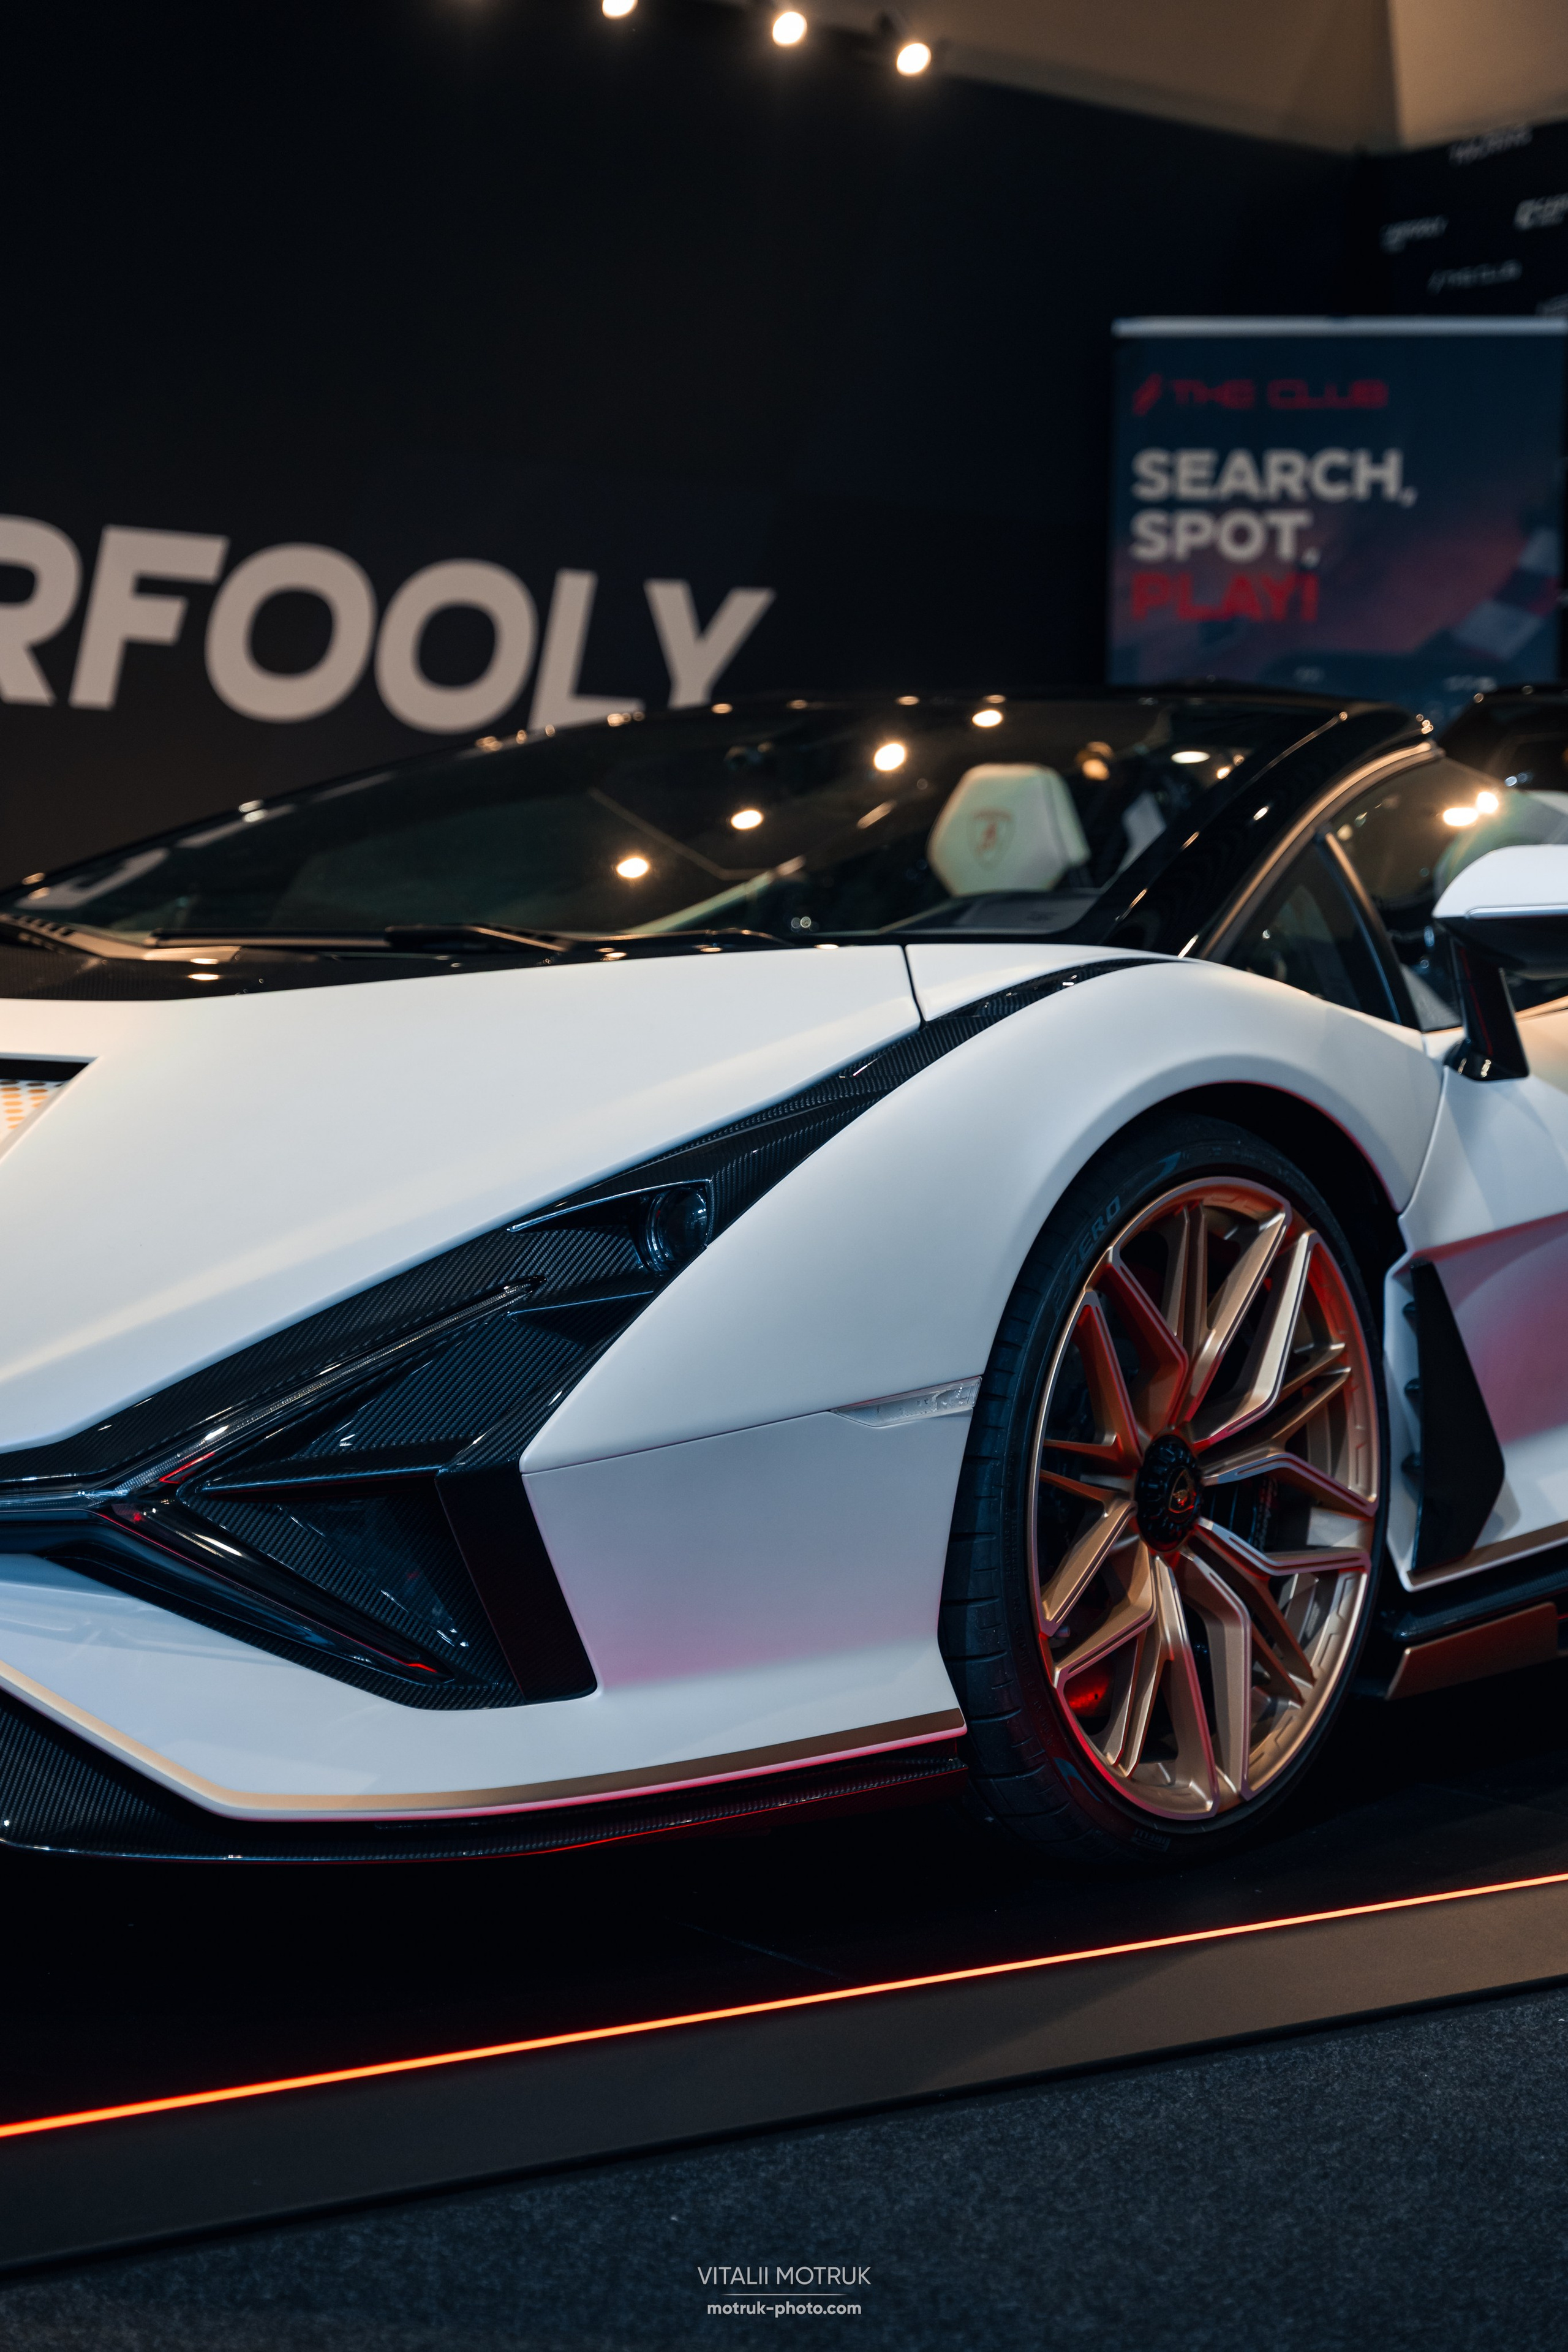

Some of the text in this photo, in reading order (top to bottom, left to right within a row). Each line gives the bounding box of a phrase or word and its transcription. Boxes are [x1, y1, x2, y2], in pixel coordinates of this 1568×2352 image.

[1171, 379, 1388, 409] THE CLUB
[1131, 448, 1418, 507] SEARCH,
[1129, 509, 1320, 568] SPOT.
[1131, 571, 1319, 622] PLAY!
[1065, 1196, 1122, 1286] ZERO
